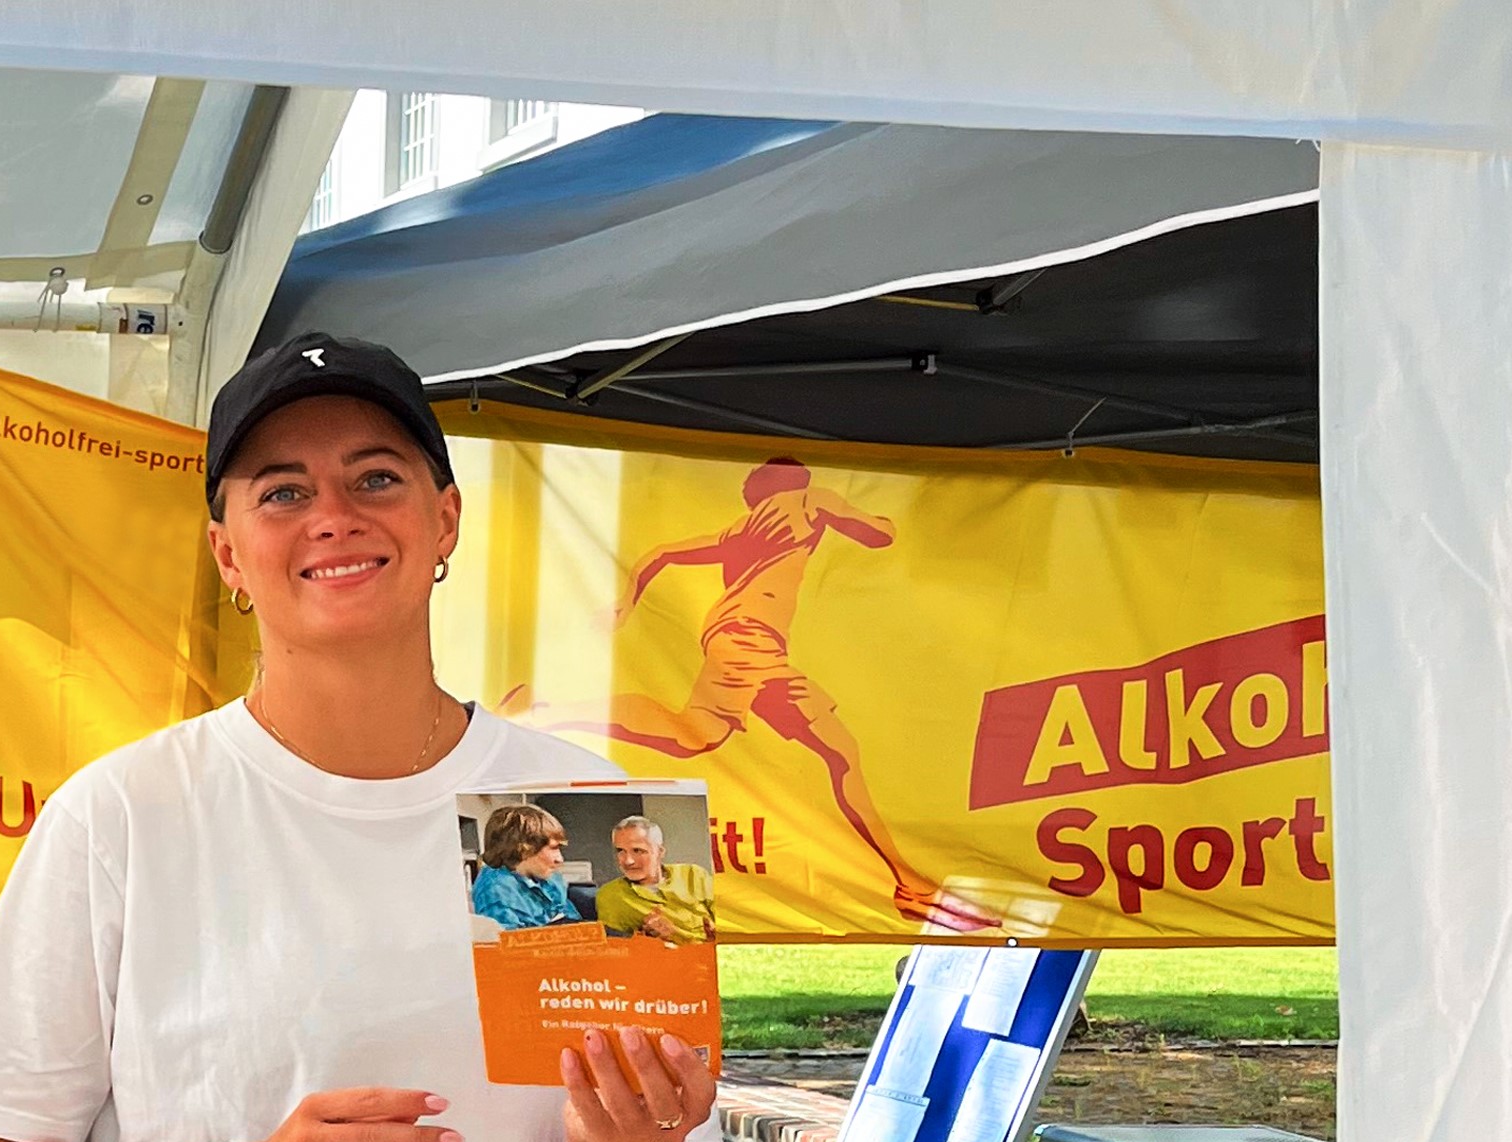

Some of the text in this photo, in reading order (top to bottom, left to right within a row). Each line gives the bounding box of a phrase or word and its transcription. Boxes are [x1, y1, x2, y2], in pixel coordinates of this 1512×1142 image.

[1036, 797, 1331, 914] Sport
[538, 978, 611, 993] Alkohol
[540, 995, 708, 1014] reden wir drüber!
